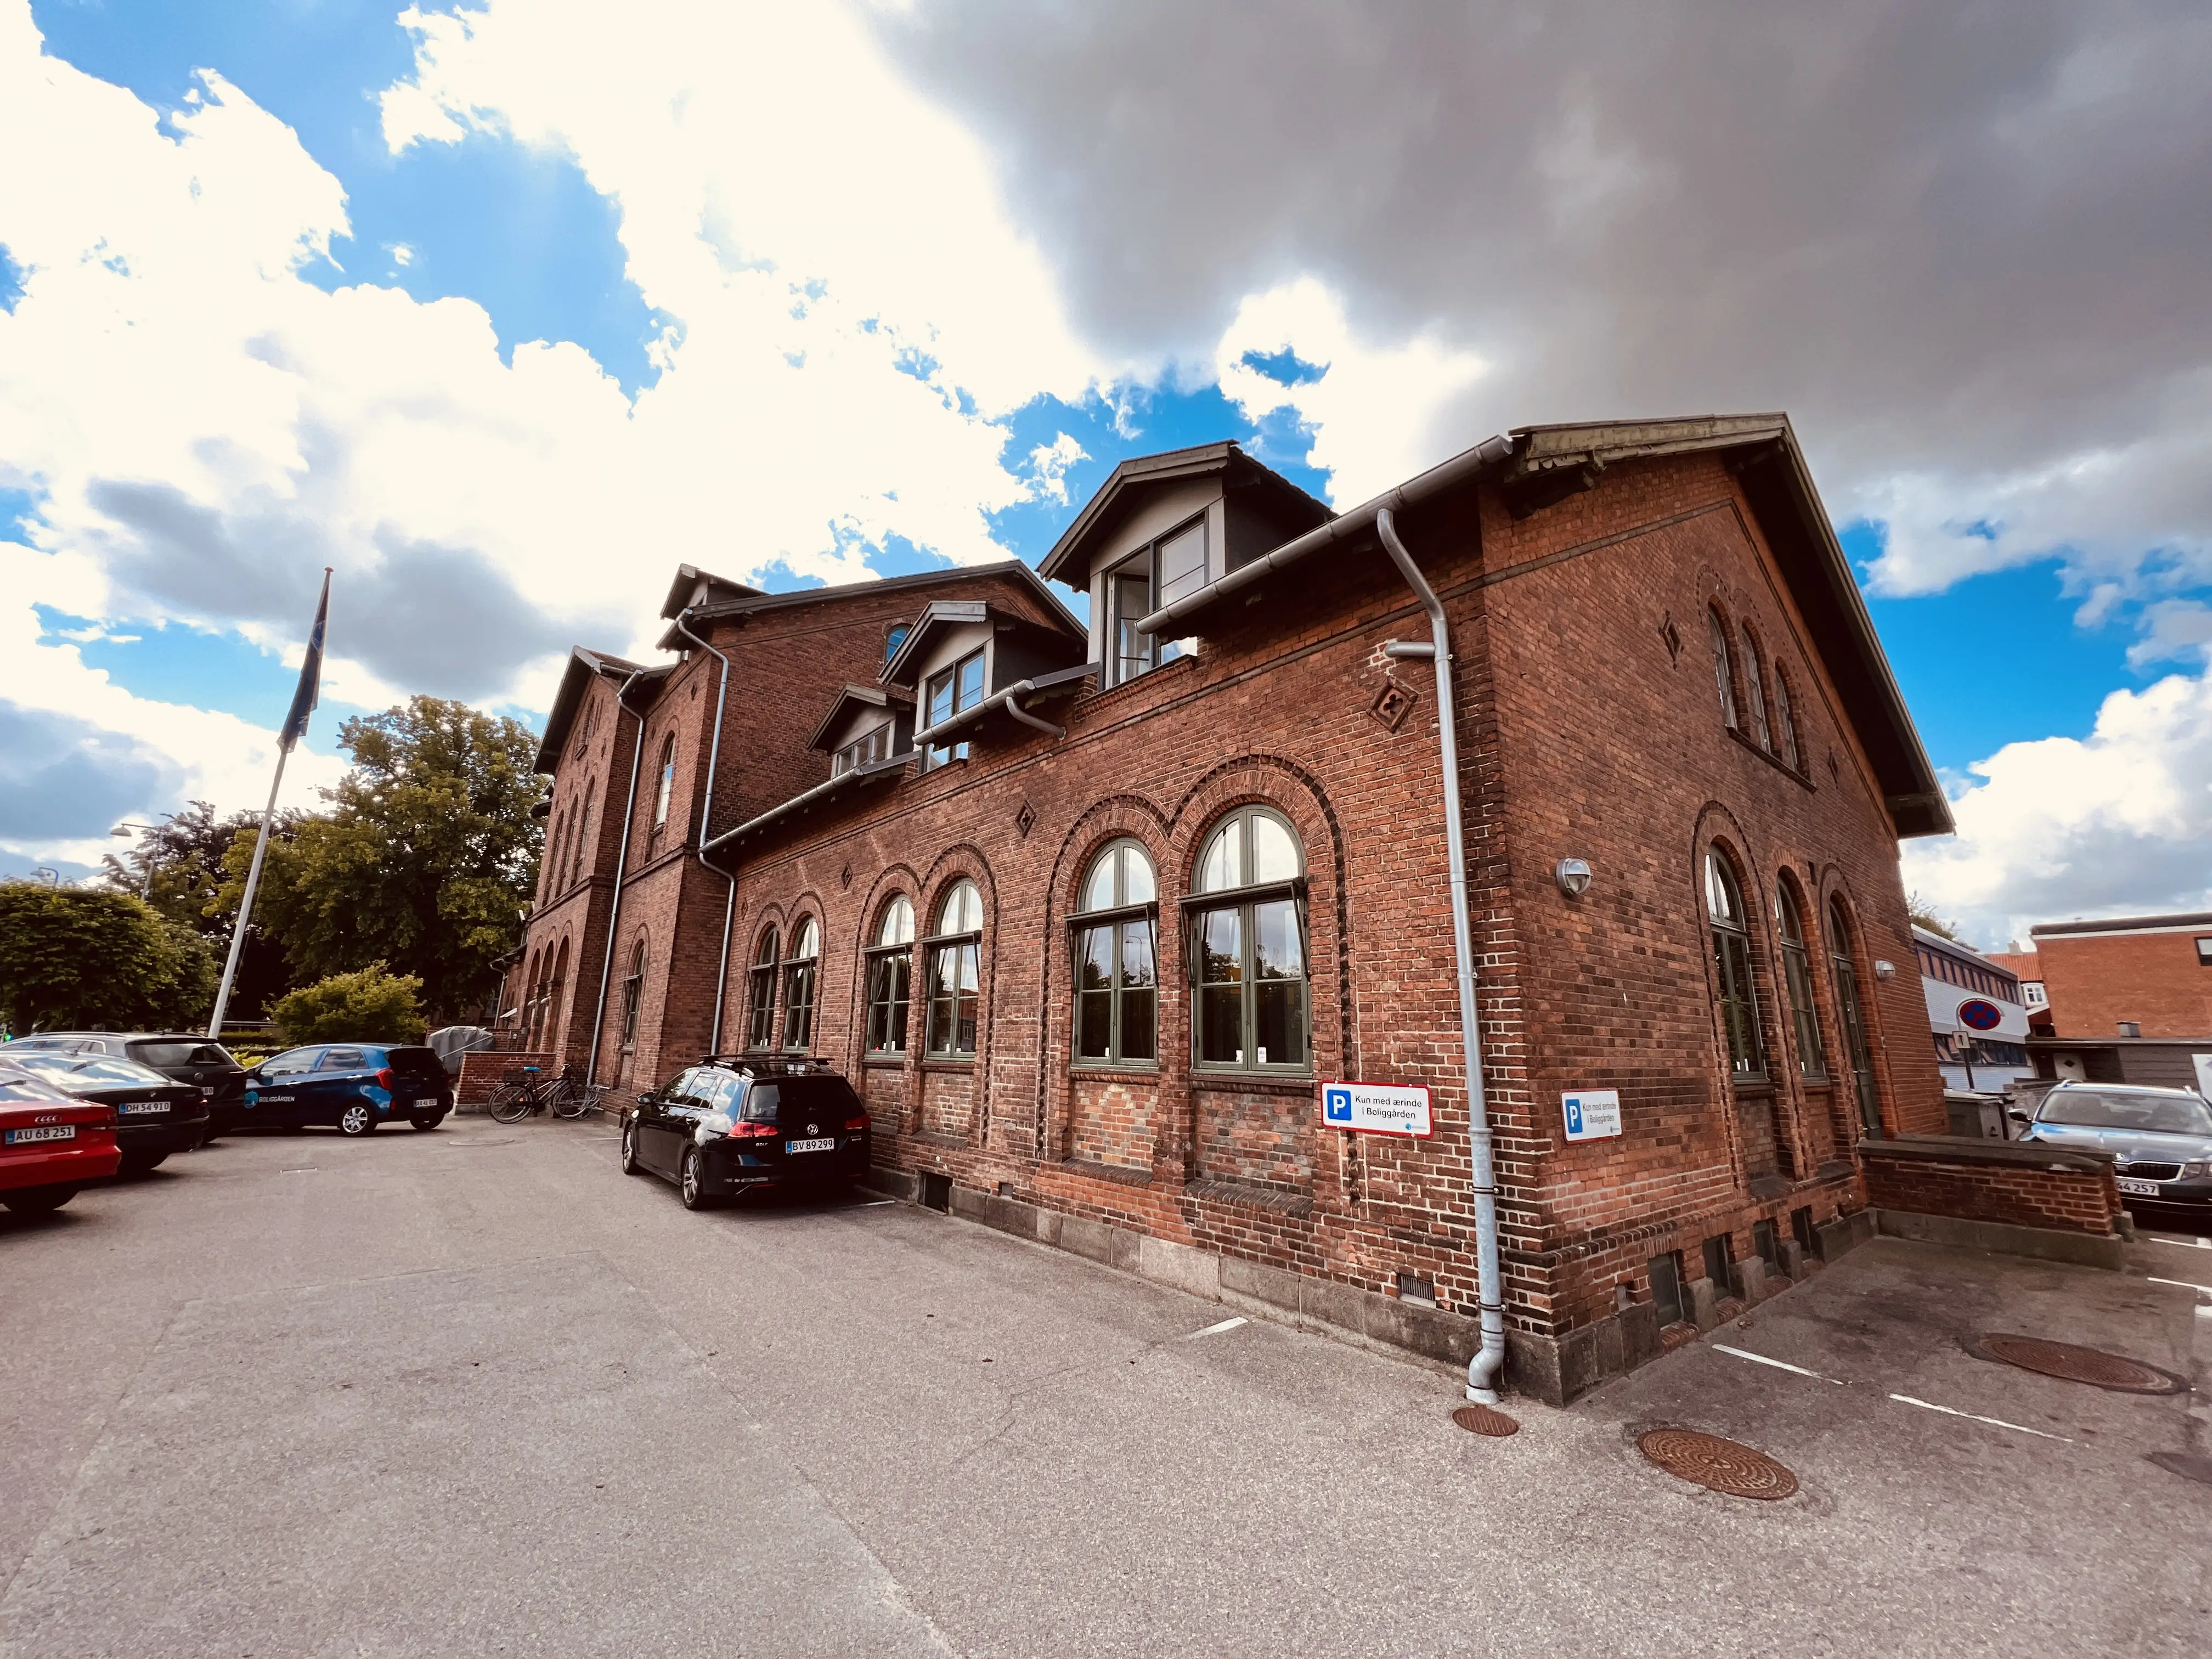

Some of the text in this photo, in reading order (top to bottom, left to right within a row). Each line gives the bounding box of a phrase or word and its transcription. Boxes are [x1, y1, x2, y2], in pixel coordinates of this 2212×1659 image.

[126, 1102, 169, 1112] DH 54 910
[1333, 1094, 1346, 1115] P
[1355, 1095, 1371, 1104] Kun
[1393, 1098, 1422, 1107] ærinde
[1582, 1103, 1592, 1111] Kun
[1592, 1102, 1602, 1111] med
[1362, 1107, 1416, 1119] i Boliggården
[1569, 1105, 1578, 1127] P
[16, 1126, 72, 1141] AU 68 251
[793, 1139, 833, 1150] BV 89 299
[2133, 1183, 2156, 1194] 257
